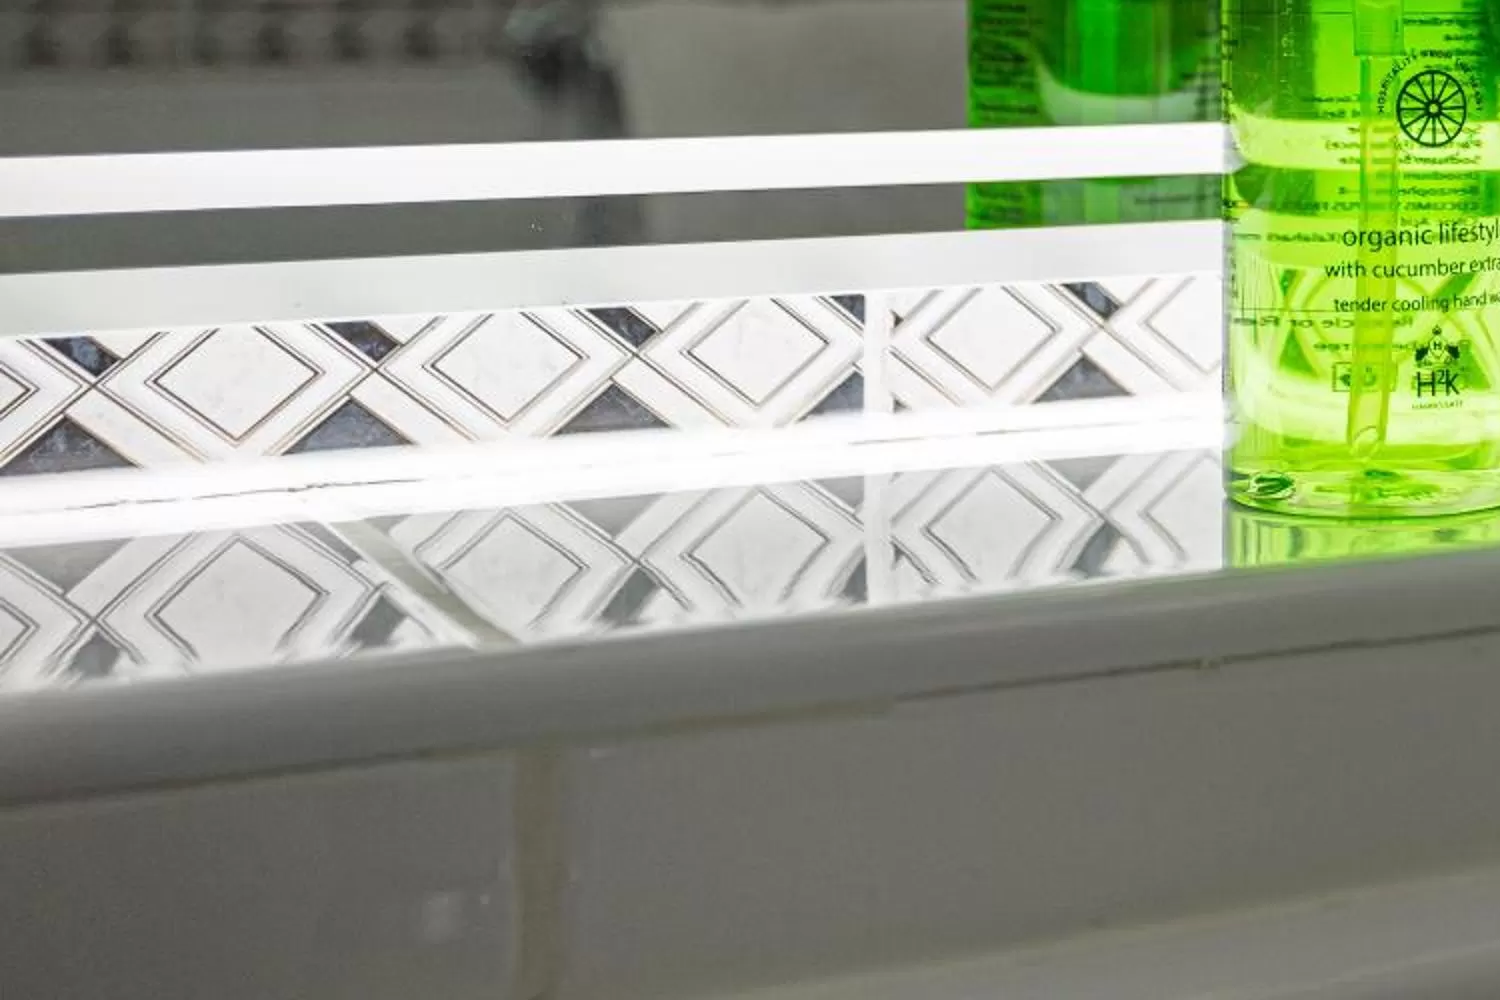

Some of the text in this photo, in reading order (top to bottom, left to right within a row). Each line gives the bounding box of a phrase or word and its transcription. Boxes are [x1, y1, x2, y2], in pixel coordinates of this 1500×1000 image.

[1342, 225, 1433, 253] organic
[1325, 260, 1367, 279] with
[1371, 258, 1466, 279] cucumber
[1333, 298, 1387, 312] tender
[1391, 296, 1449, 314] cooling
[1453, 290, 1487, 308] hand
